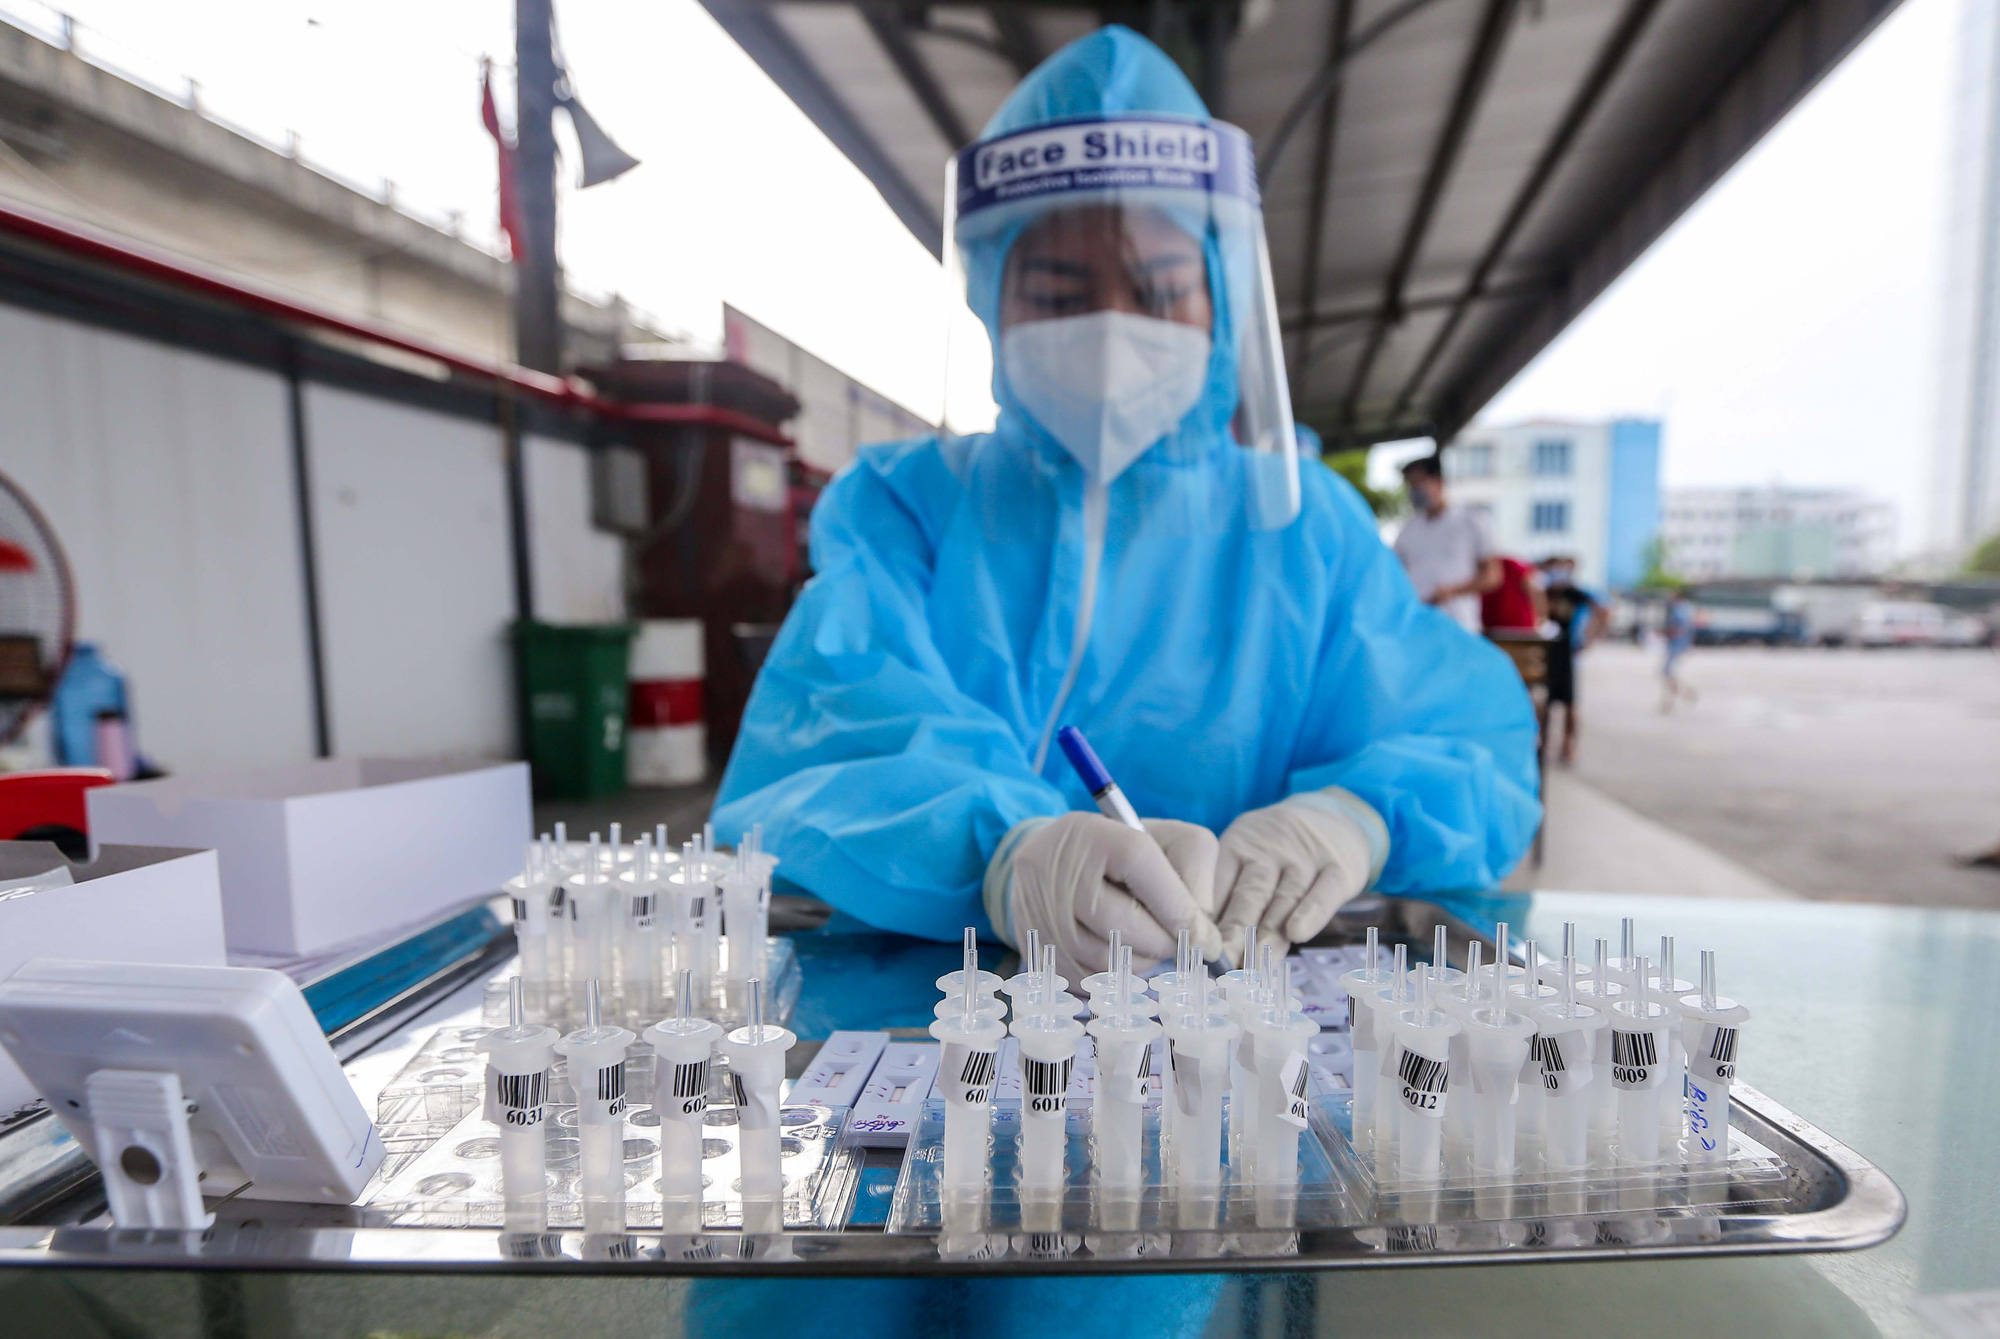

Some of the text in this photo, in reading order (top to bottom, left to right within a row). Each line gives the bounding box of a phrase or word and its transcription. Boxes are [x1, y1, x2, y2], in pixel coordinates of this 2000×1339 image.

[982, 131, 1210, 179] Face Shield
[1613, 1066, 1648, 1084] 6009
[1716, 1064, 1735, 1080] 60
[608, 1097, 627, 1116] 60
[1402, 1086, 1438, 1110] 6012
[506, 1107, 544, 1126] 6031
